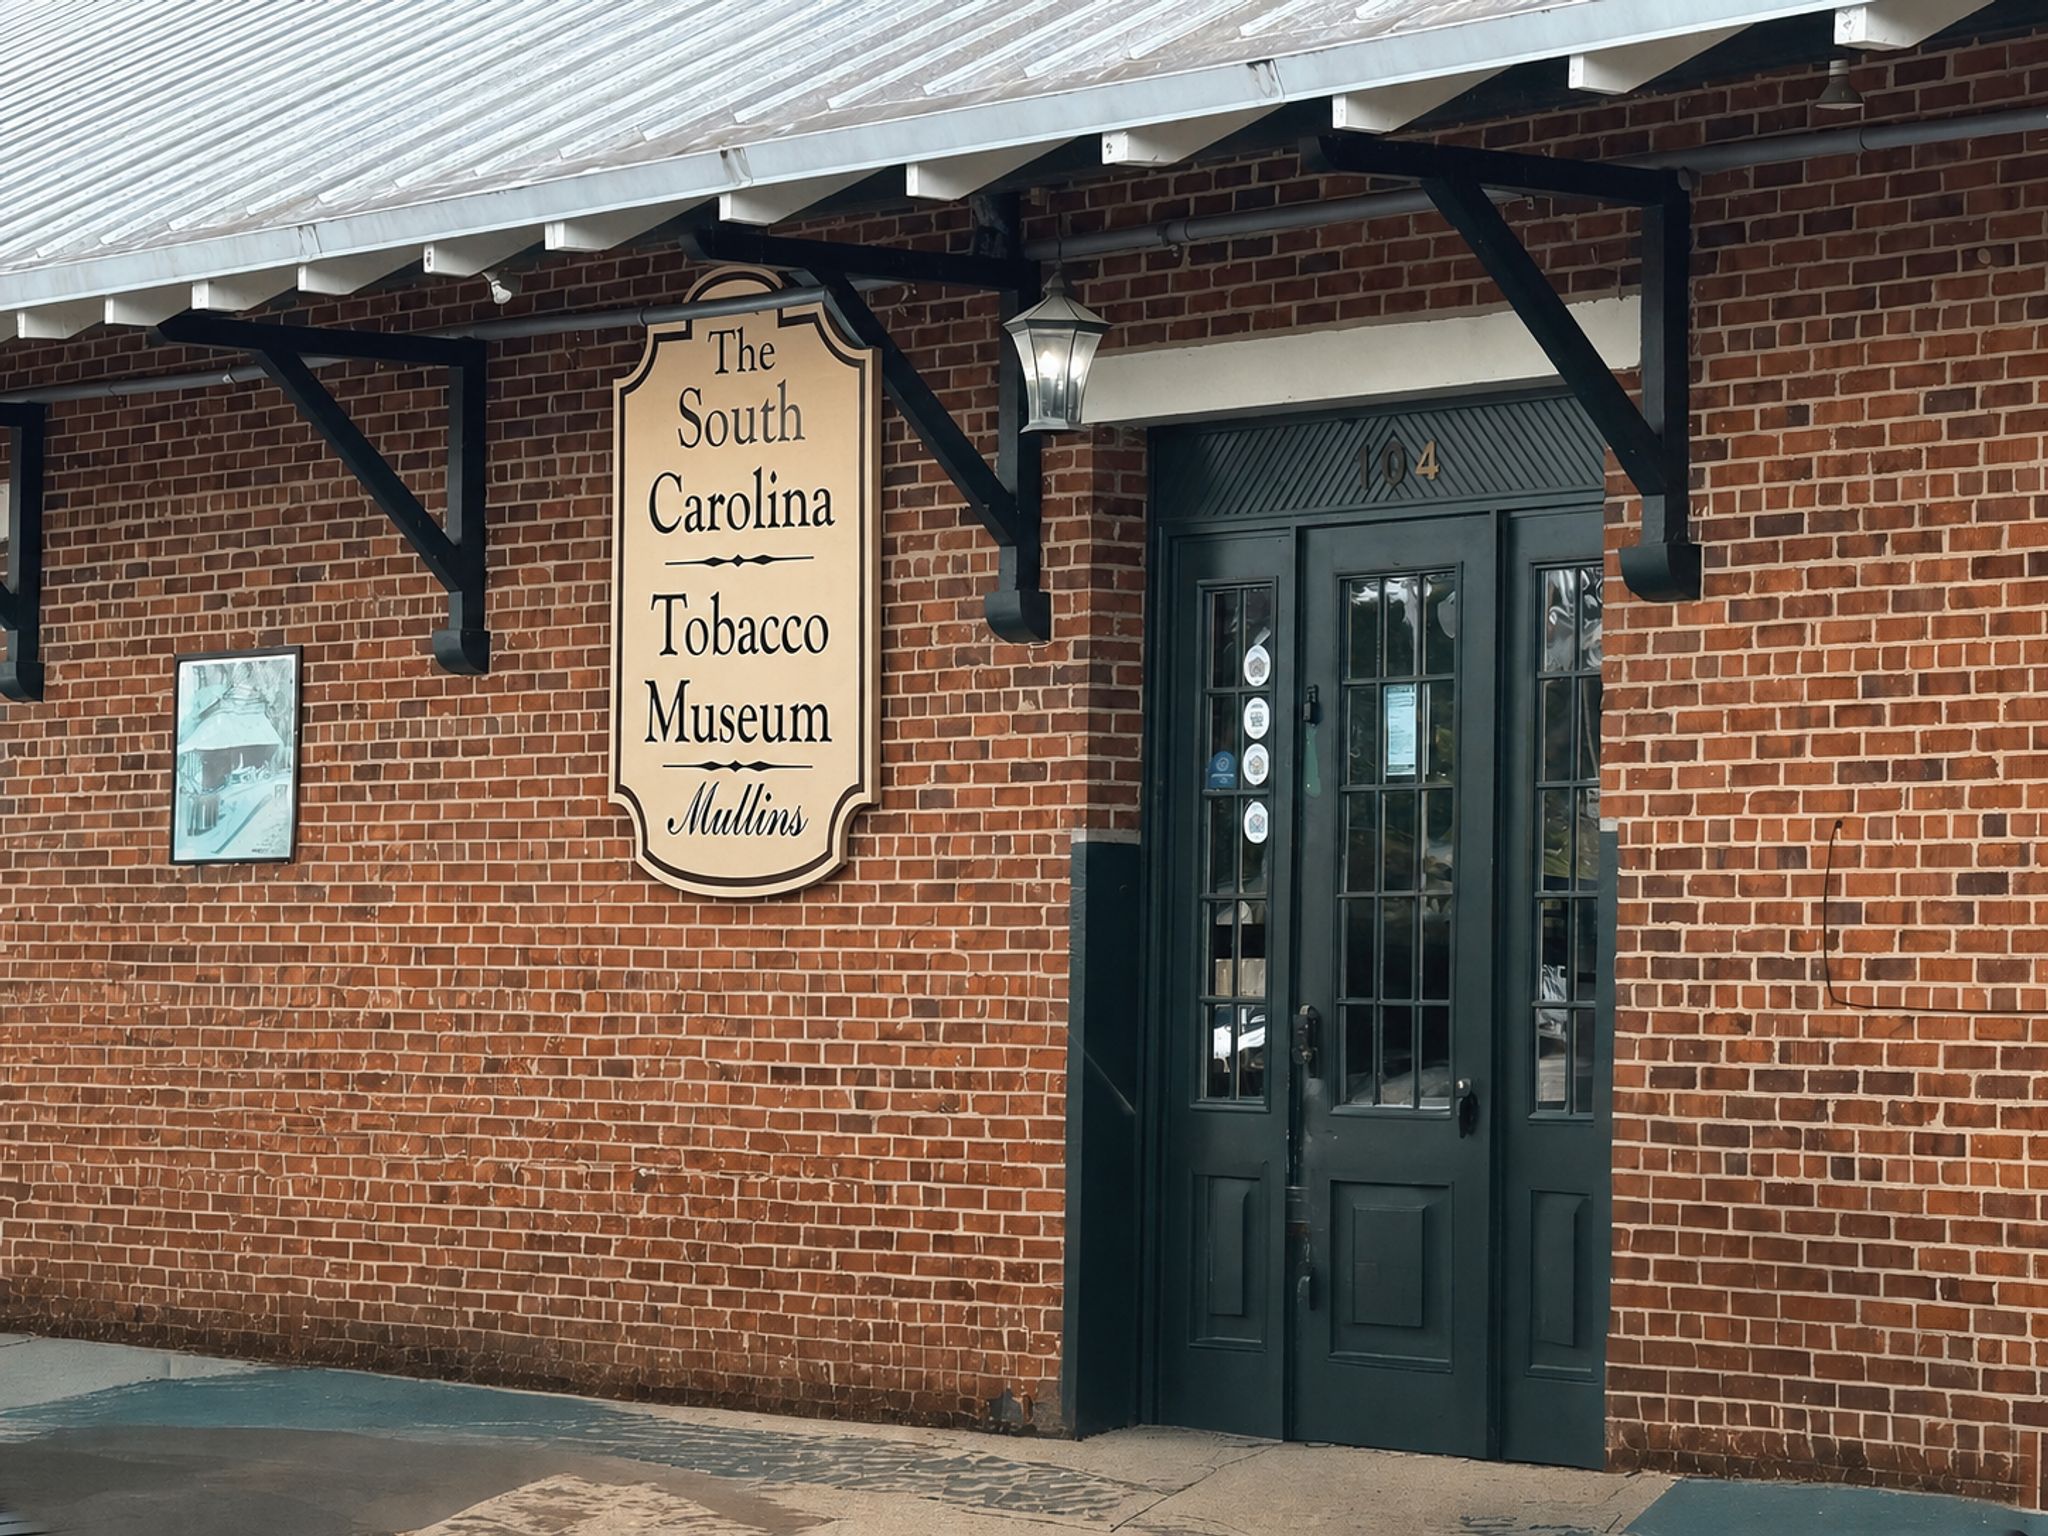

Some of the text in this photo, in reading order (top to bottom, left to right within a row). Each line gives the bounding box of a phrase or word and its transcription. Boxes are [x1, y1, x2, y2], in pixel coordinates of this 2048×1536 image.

[707, 326, 776, 375] The
[677, 378, 805, 449] South
[1353, 438, 1441, 492] 104
[649, 466, 836, 535] Carolina
[650, 591, 829, 656] Tobacco
[644, 679, 833, 743] Museum
[667, 781, 810, 837] Mullins
